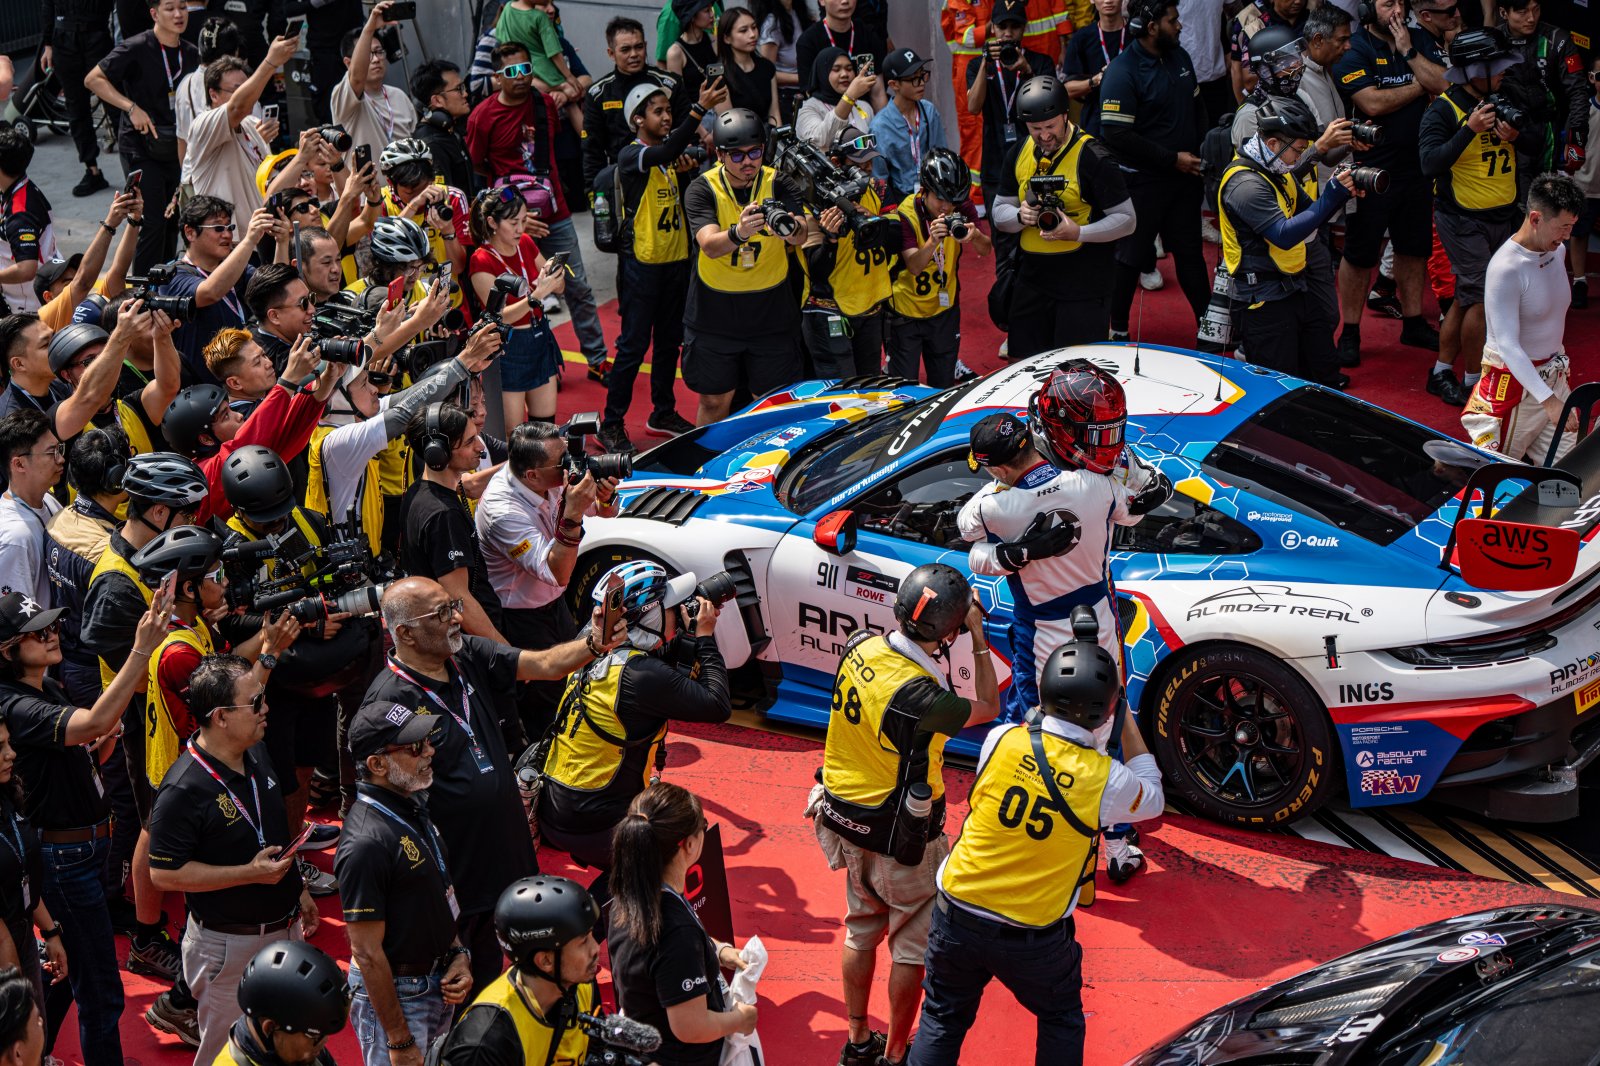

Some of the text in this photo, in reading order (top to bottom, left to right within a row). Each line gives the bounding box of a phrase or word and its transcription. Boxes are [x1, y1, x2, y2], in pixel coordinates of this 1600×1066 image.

[1481, 148, 1512, 177] 72
[915, 271, 948, 296] 89
[1281, 530, 1340, 550] B-Quik
[1482, 524, 1549, 553] aws
[816, 562, 839, 590] 911
[856, 587, 885, 602] ROWE
[1186, 603, 1361, 624] ALMOST REAL
[832, 673, 862, 725] 68
[1158, 660, 1198, 738] PIRELLI
[1339, 682, 1395, 703] INGS
[1352, 725, 1403, 733] PORSCHE
[1274, 747, 1323, 822] P ZERO
[1371, 775, 1422, 796] KW
[998, 785, 1059, 841] 05
